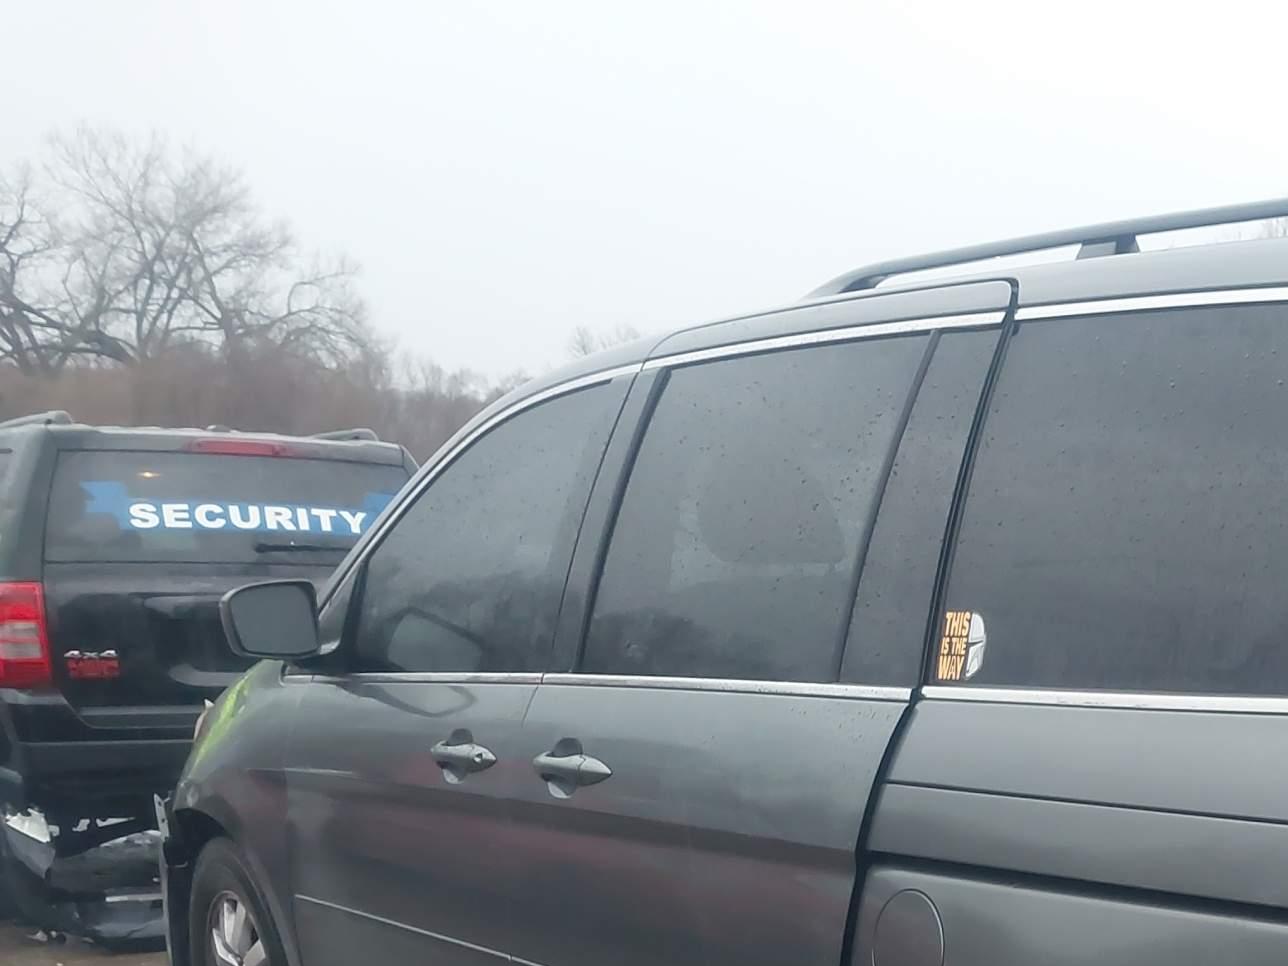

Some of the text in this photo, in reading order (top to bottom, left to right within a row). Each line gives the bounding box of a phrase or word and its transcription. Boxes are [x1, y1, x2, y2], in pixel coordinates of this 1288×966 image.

[129, 503, 366, 534] SECURITY
[945, 612, 970, 637] THIS
[941, 637, 967, 655] IS THE
[938, 656, 964, 681] WAY
